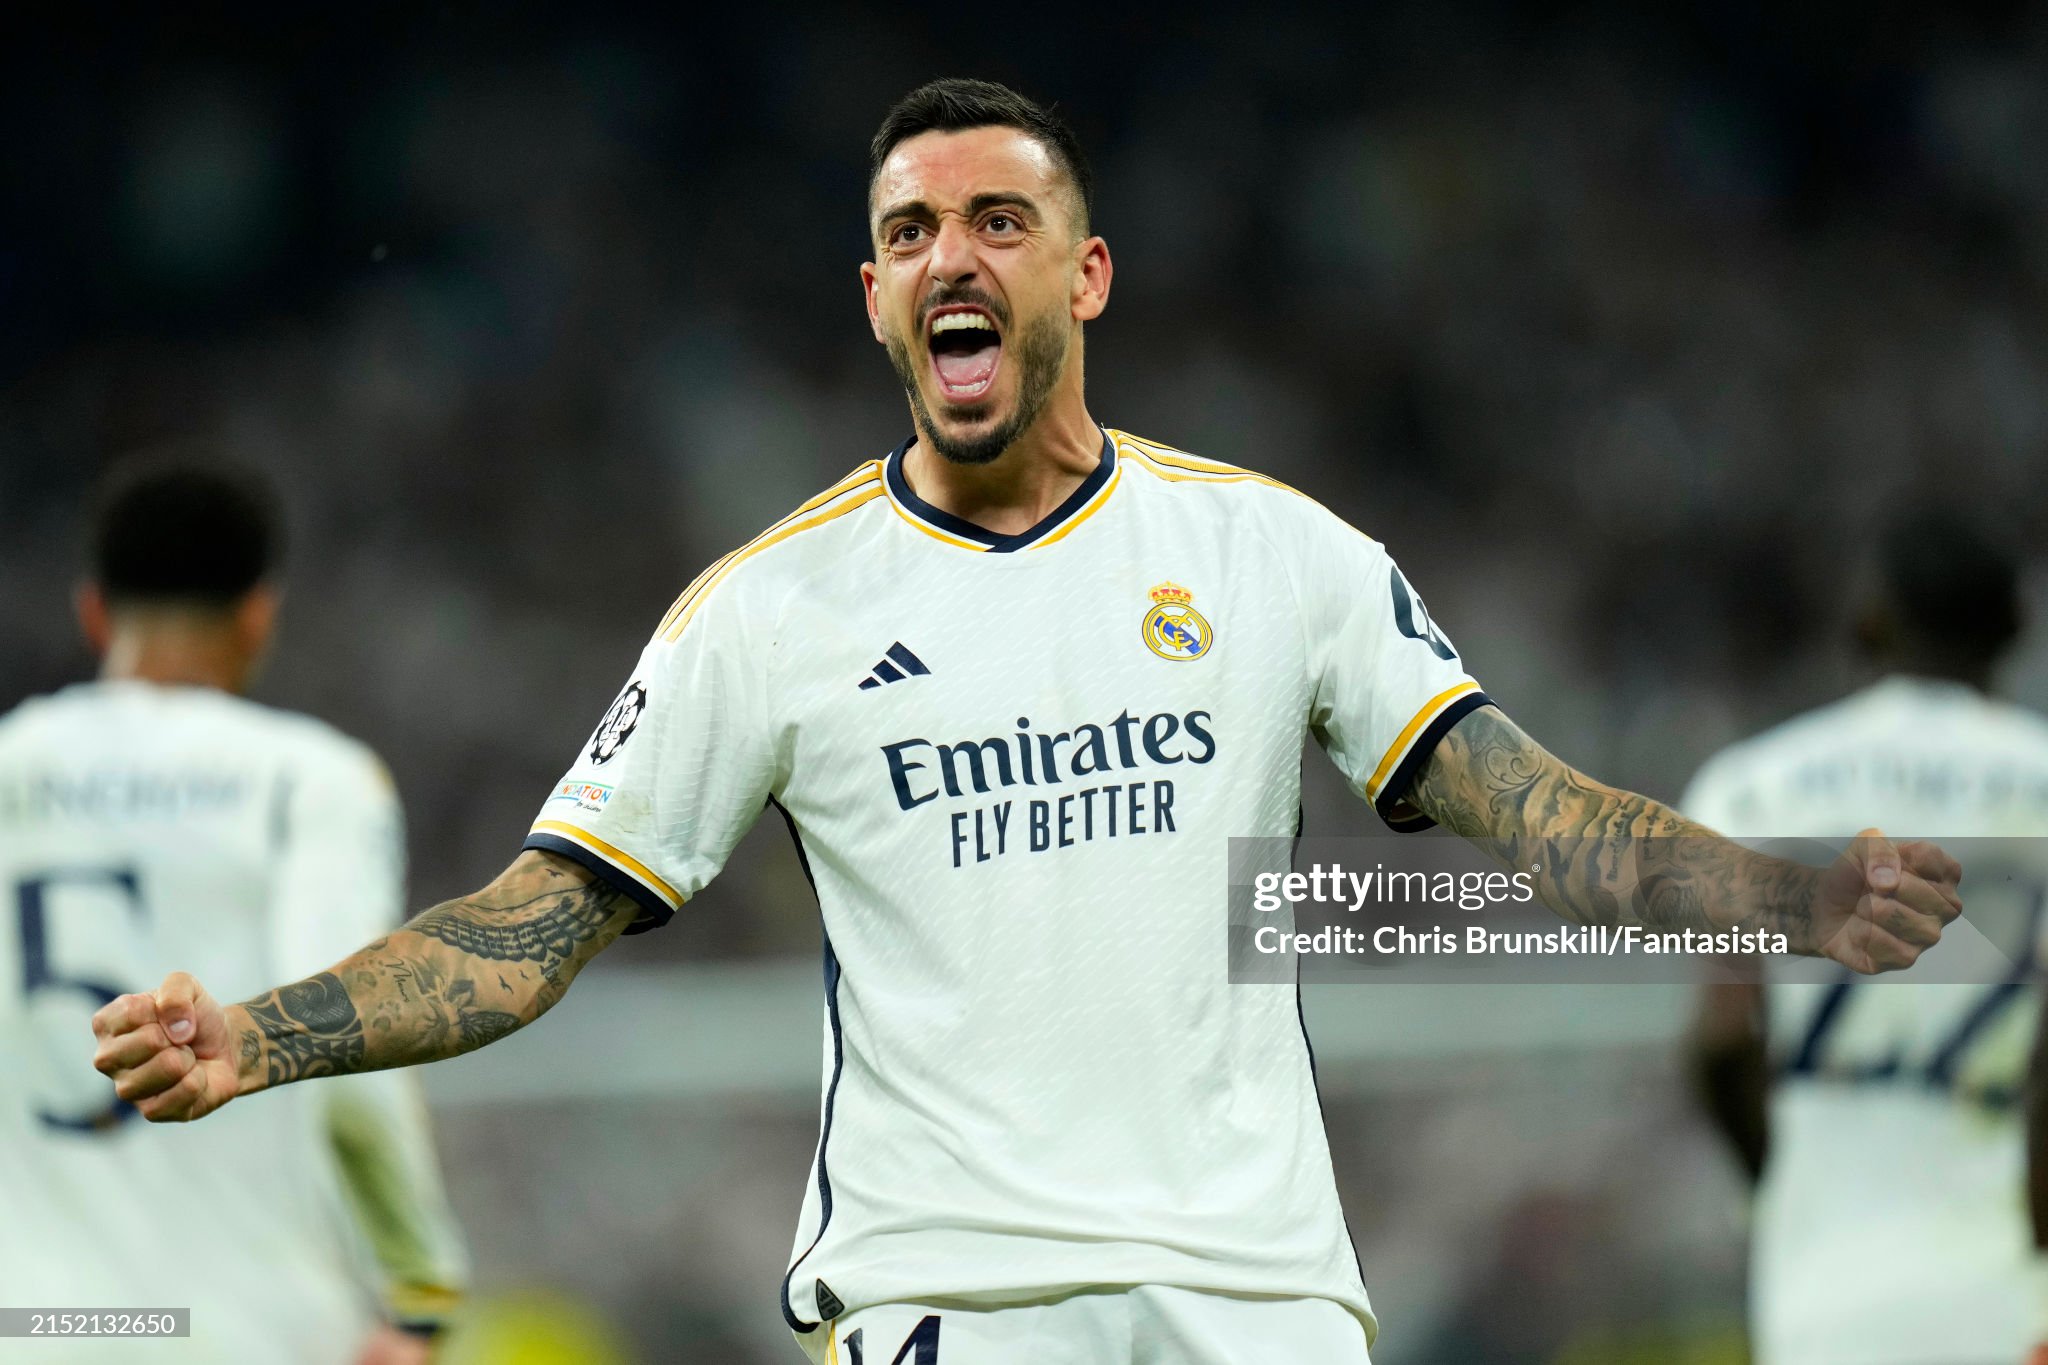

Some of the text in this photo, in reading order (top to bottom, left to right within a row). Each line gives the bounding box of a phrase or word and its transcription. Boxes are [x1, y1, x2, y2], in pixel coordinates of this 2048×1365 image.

[880, 708, 1216, 811] Emirates
[951, 780, 1177, 868] FLY BETTER
[14, 862, 150, 1140] 5
